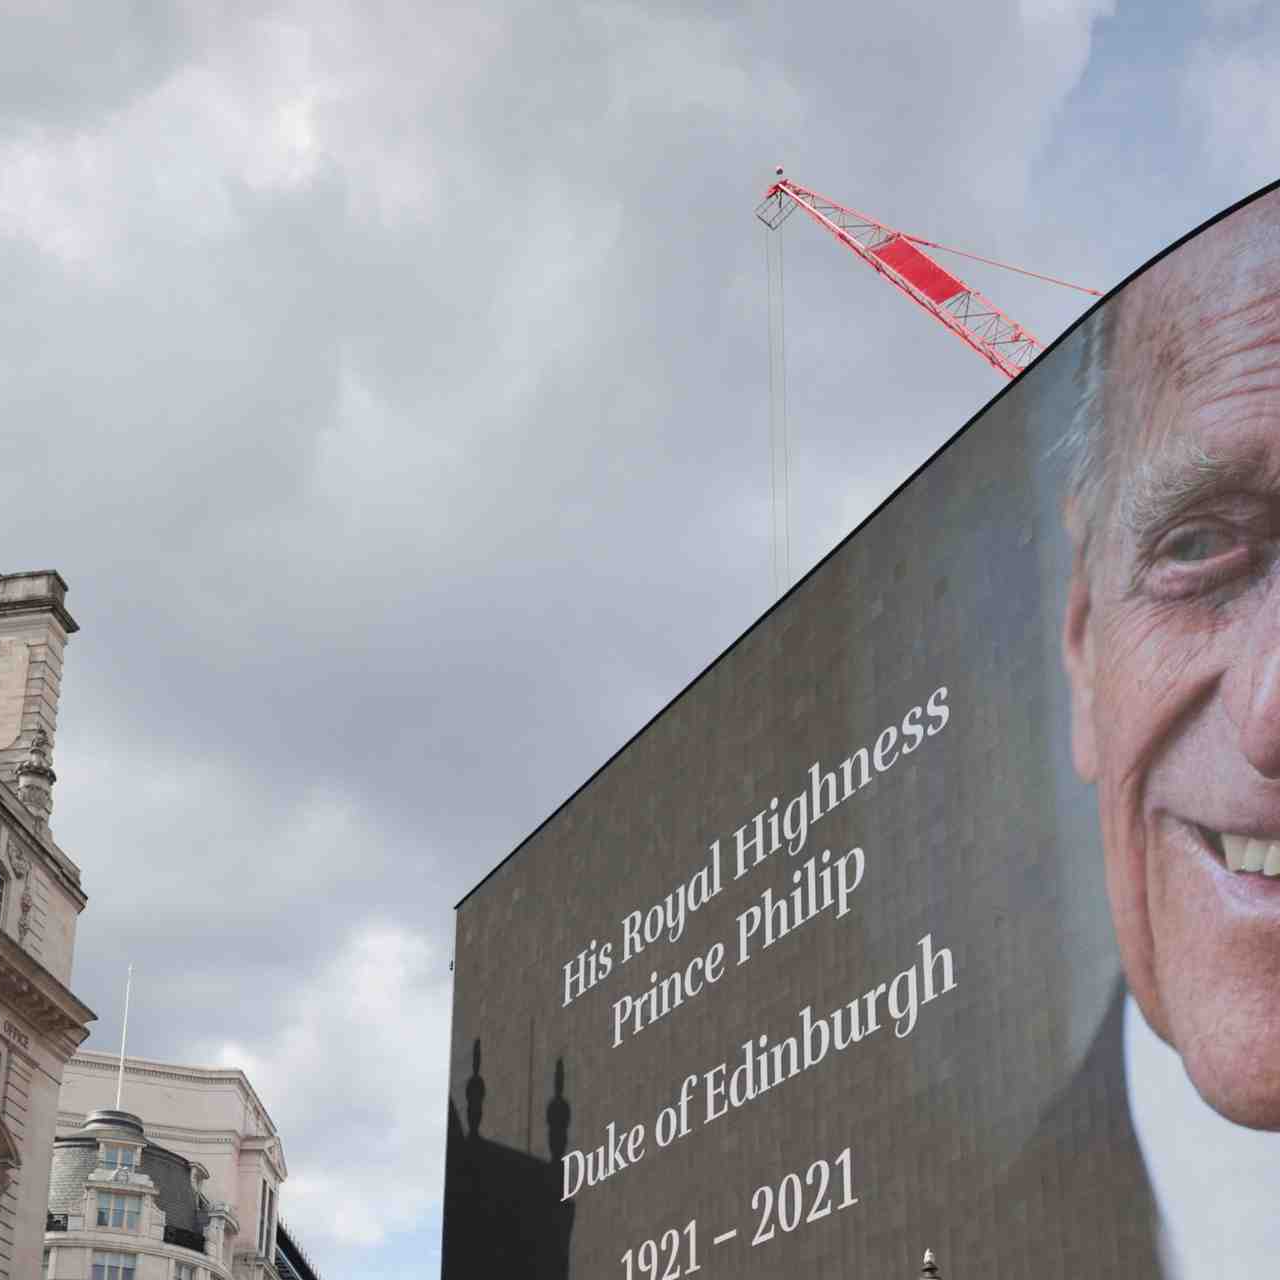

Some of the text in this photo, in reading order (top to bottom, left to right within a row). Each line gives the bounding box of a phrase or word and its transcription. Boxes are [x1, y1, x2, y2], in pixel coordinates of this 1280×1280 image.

[562, 685, 951, 1007] His Royal Highness
[611, 846, 865, 1048] Prince Philip
[561, 933, 957, 1201] Duke of Edinburgh
[751, 1147, 859, 1246] 2021
